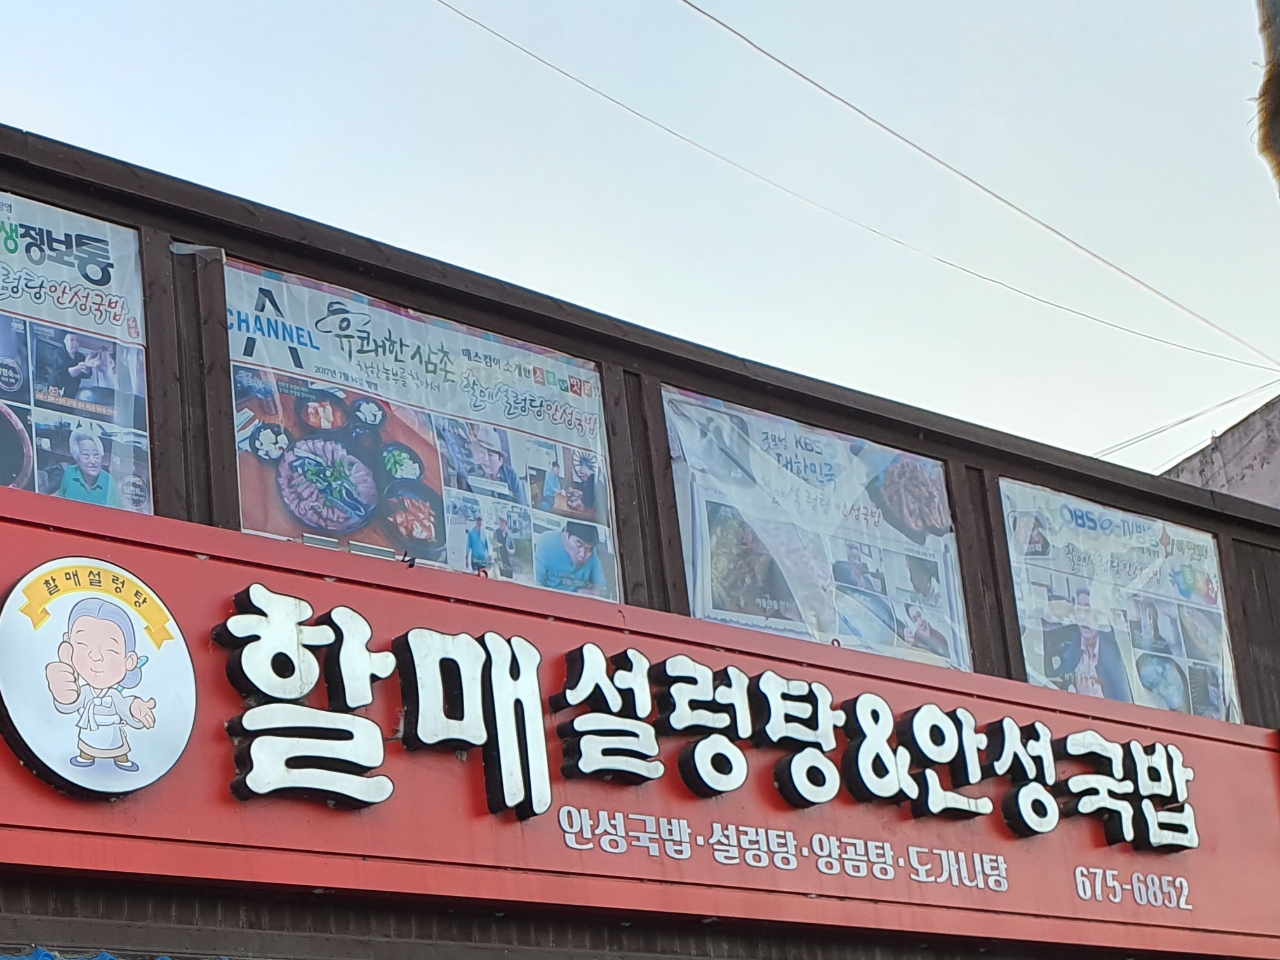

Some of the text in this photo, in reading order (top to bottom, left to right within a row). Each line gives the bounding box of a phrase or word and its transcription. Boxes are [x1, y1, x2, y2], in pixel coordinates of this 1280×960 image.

[227, 307, 320, 351] CHANNEL
[333, 316, 410, 364] 유쾌한
[794, 434, 824, 456] KBS
[42, 567, 150, 609] 할매설렁탕
[1075, 866, 1194, 910] 675-6852
